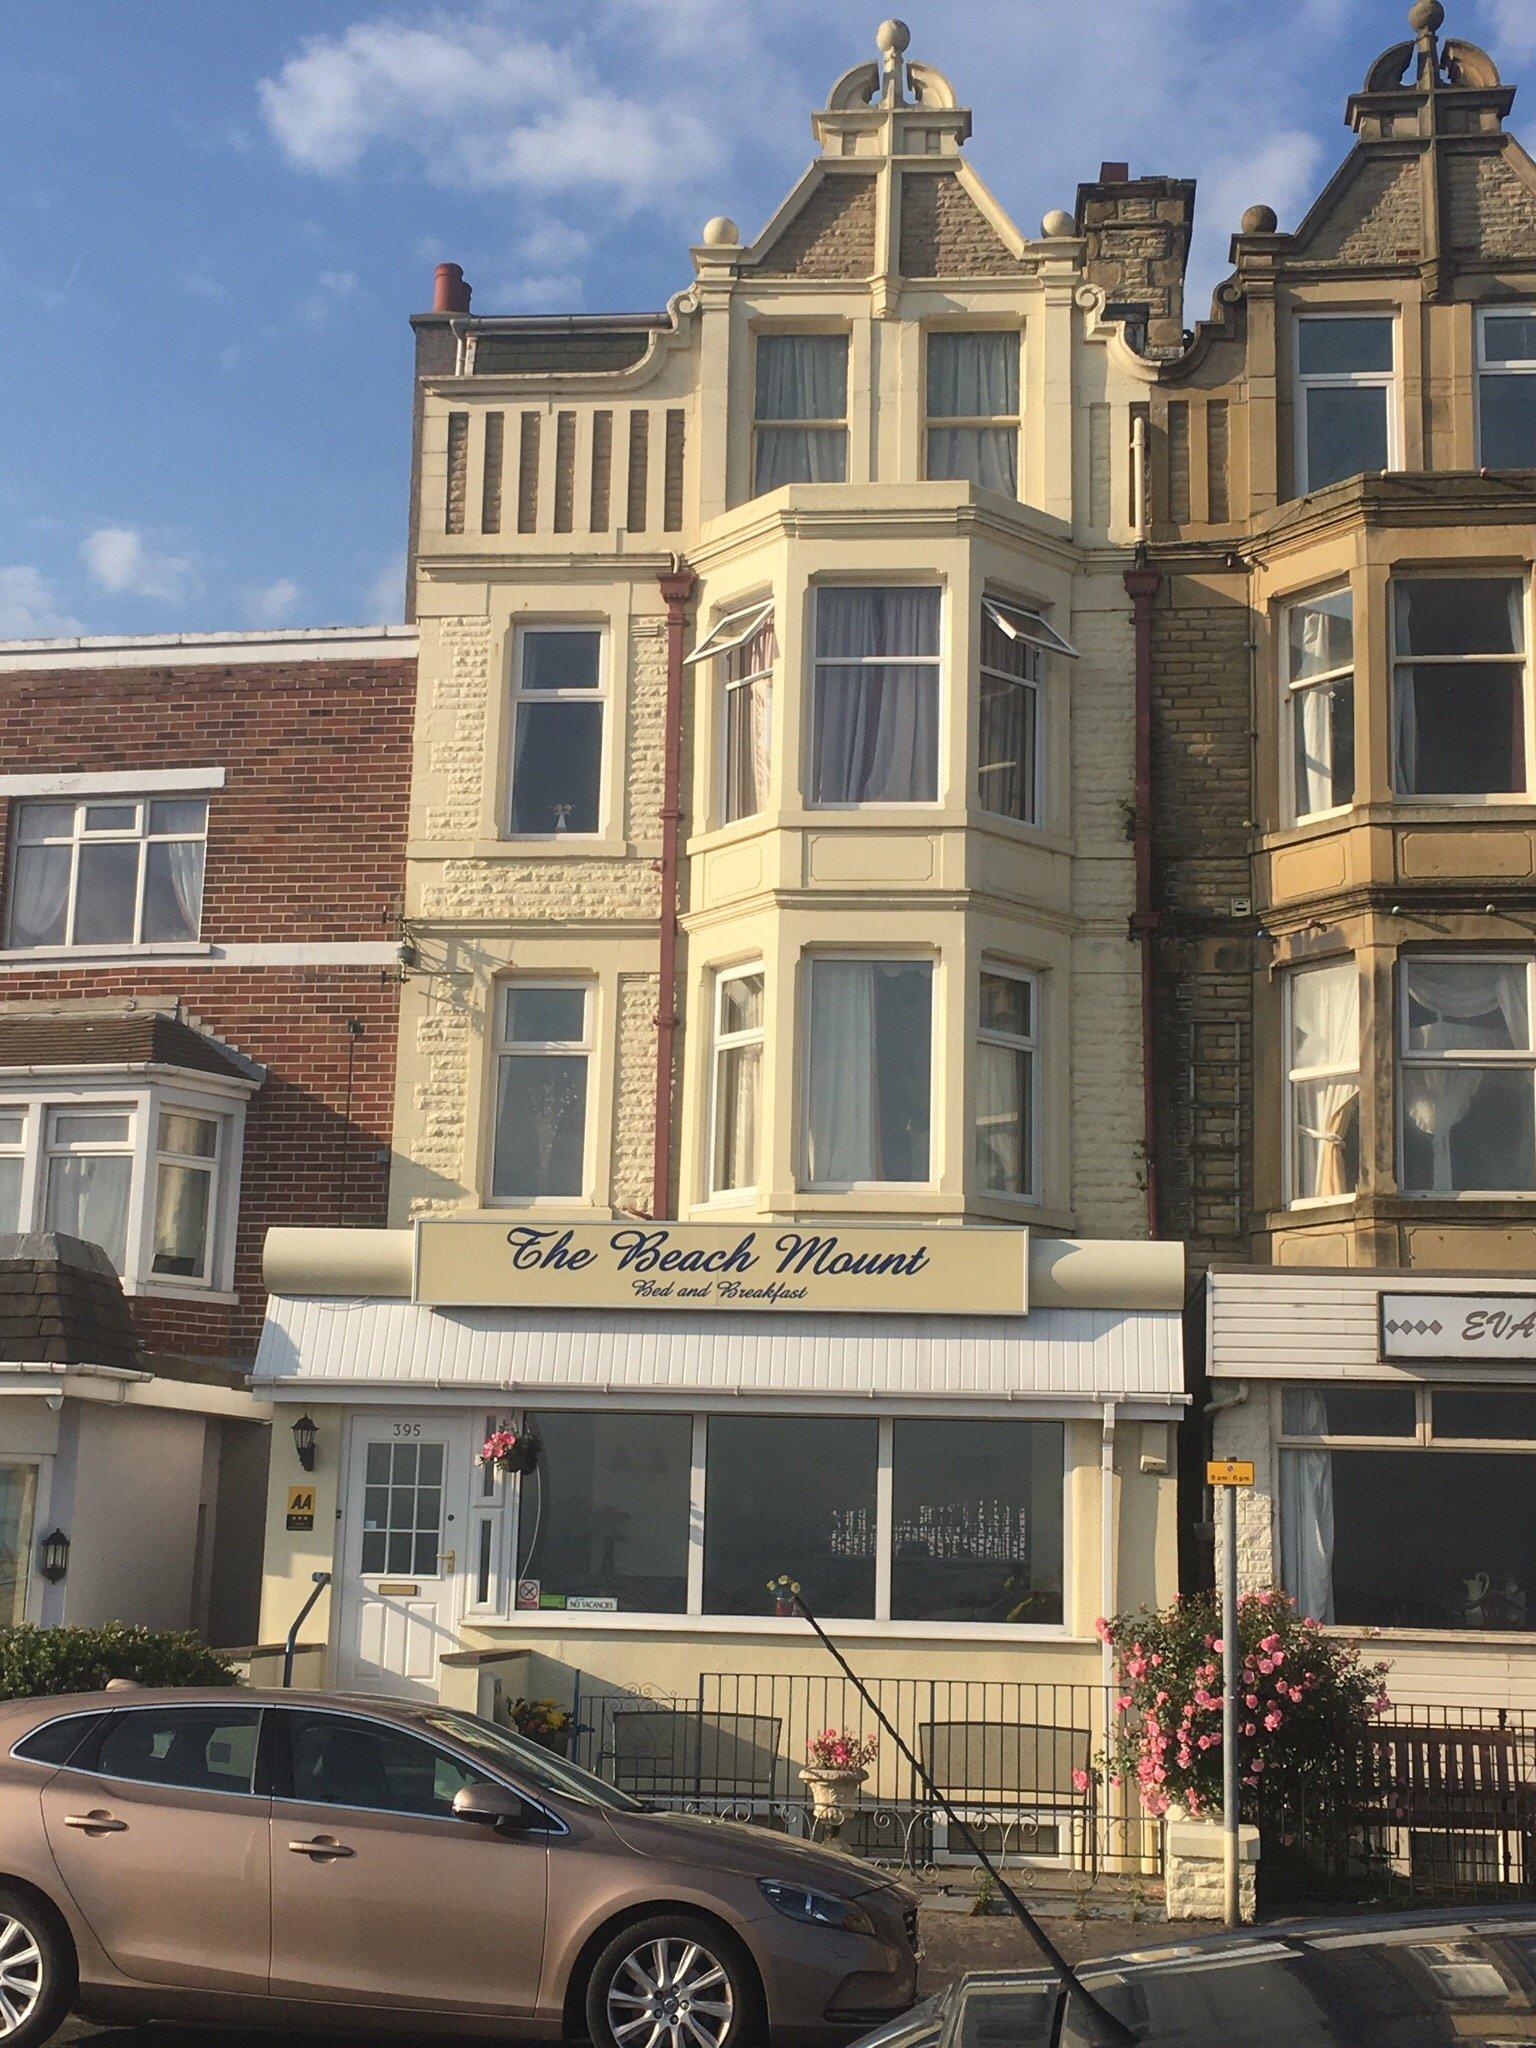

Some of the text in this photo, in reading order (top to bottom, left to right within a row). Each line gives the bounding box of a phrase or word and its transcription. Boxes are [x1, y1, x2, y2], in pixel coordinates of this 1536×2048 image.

[507, 1227, 930, 1277] The Beach Mount
[632, 1279, 809, 1305] Bed and Breakfast
[1462, 1310, 1536, 1340] EVA
[393, 1423, 421, 1437] 395
[291, 1493, 312, 1510] AA
[570, 1600, 614, 1609] NO VACANCIES
